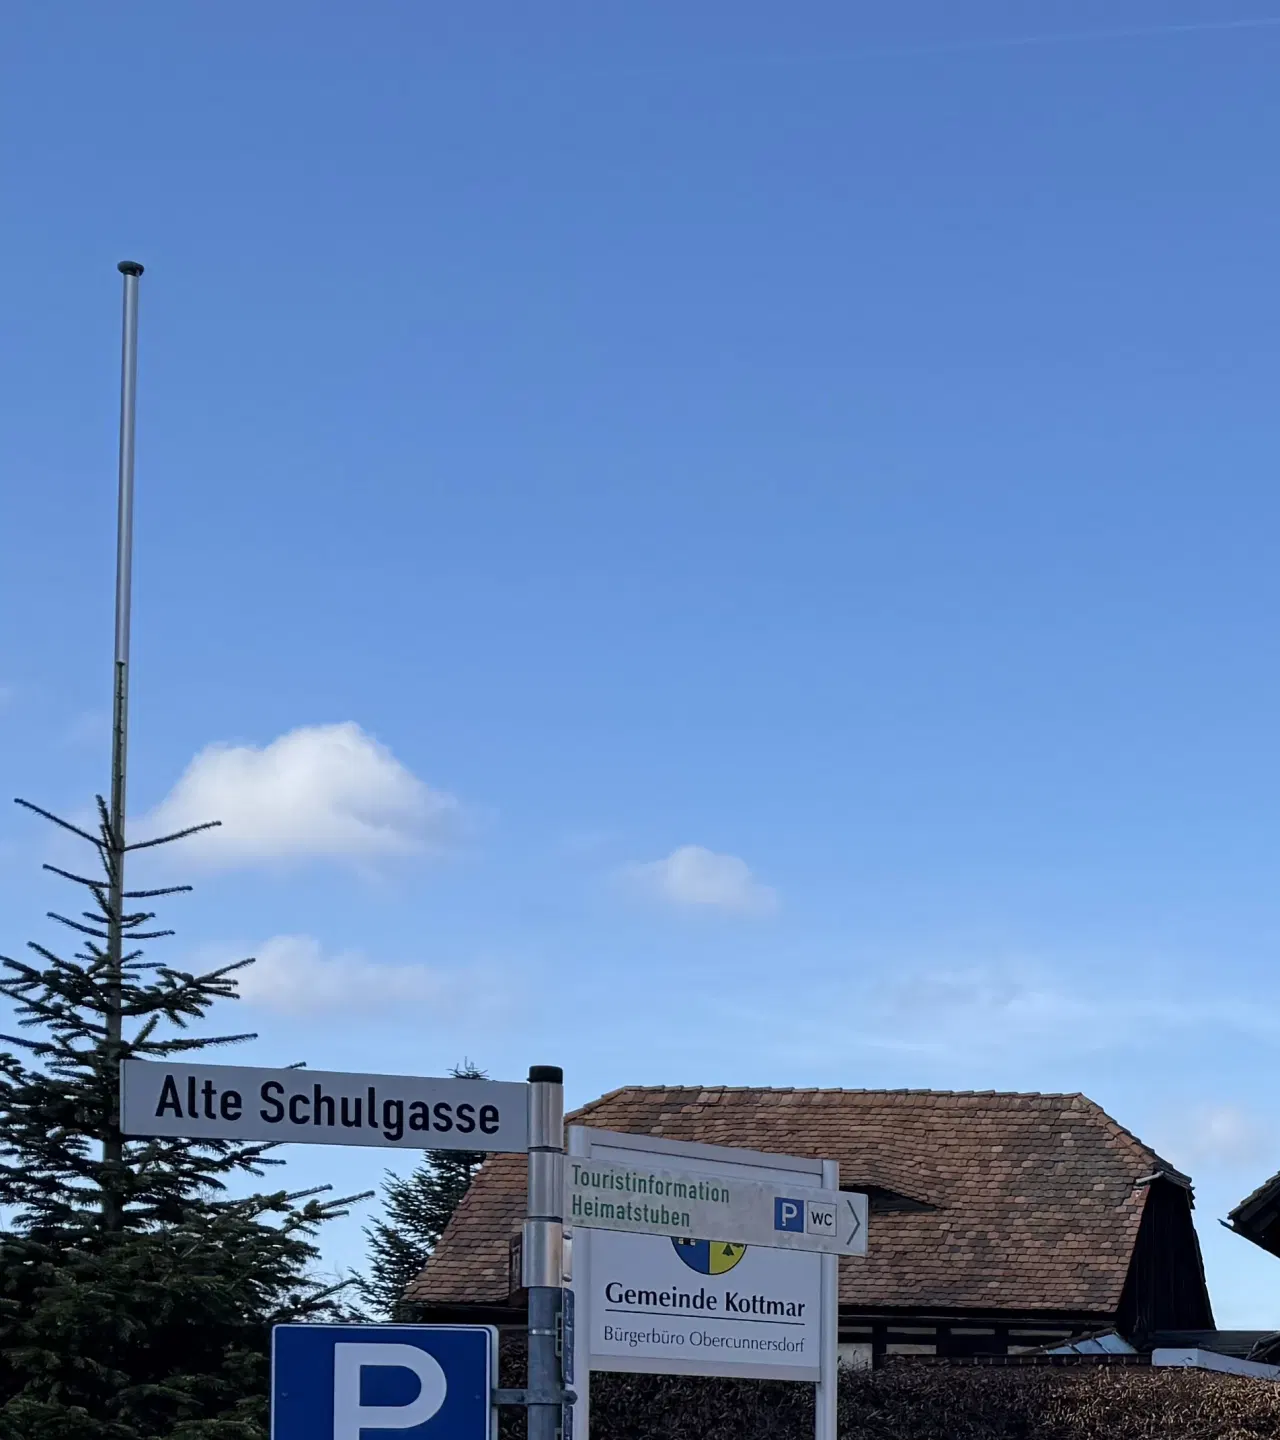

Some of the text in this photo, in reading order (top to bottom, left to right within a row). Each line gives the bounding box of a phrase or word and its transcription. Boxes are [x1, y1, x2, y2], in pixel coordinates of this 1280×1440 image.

[155, 1074, 500, 1142] Alte Schulgasse
[571, 1164, 730, 1203] Touristinformation
[571, 1194, 691, 1228] Heimatstuben
[780, 1202, 833, 1227] P WC
[605, 1282, 806, 1318] Gemeinde Kottmar
[603, 1325, 806, 1353] Bürgerbüro Obercunnersdorf
